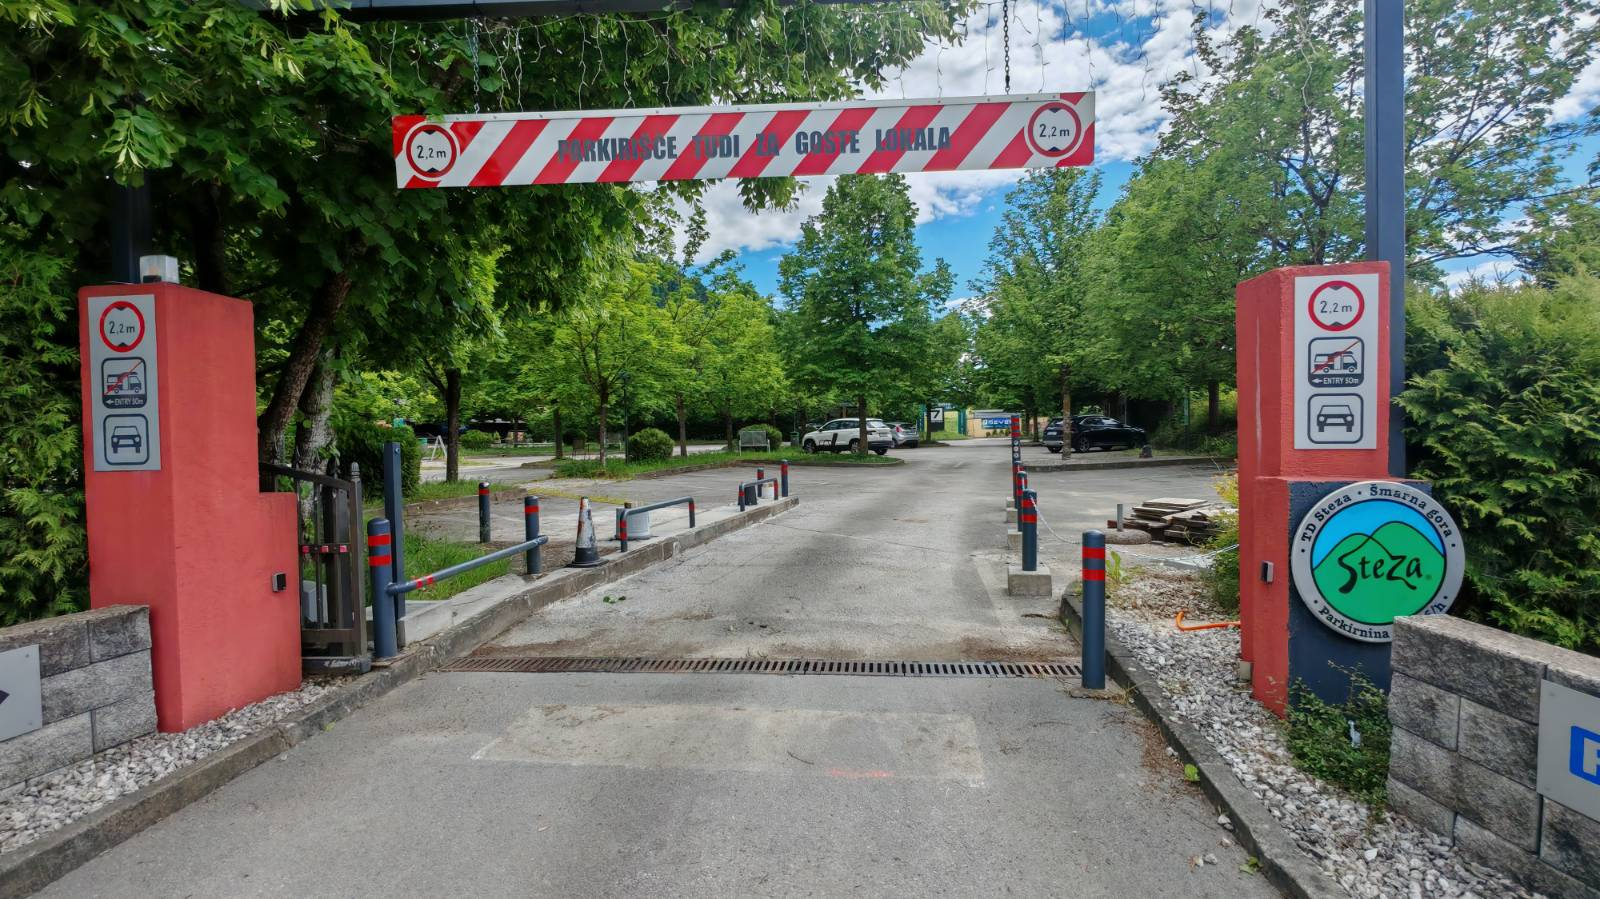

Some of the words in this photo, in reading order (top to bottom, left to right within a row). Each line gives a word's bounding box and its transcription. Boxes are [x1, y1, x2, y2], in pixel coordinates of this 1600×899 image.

[1039, 123, 1057, 139] 2,2
[692, 134, 740, 159] TUDI
[755, 131, 780, 157] ZA
[795, 129, 860, 155] GOSTE
[875, 126, 951, 152] LOKALA
[416, 145, 434, 160] 2,2
[1320, 300, 1339, 314] 2,2
[108, 320, 125, 335] 2,2
[1323, 377, 1344, 385] ENTRY
[1300, 522, 1317, 542] TD
[1314, 494, 1352, 522] Steza
[1369, 483, 1427, 509] Šmarna
[1426, 509, 1453, 538] gora
[1318, 605, 1390, 639] Parkirnina
